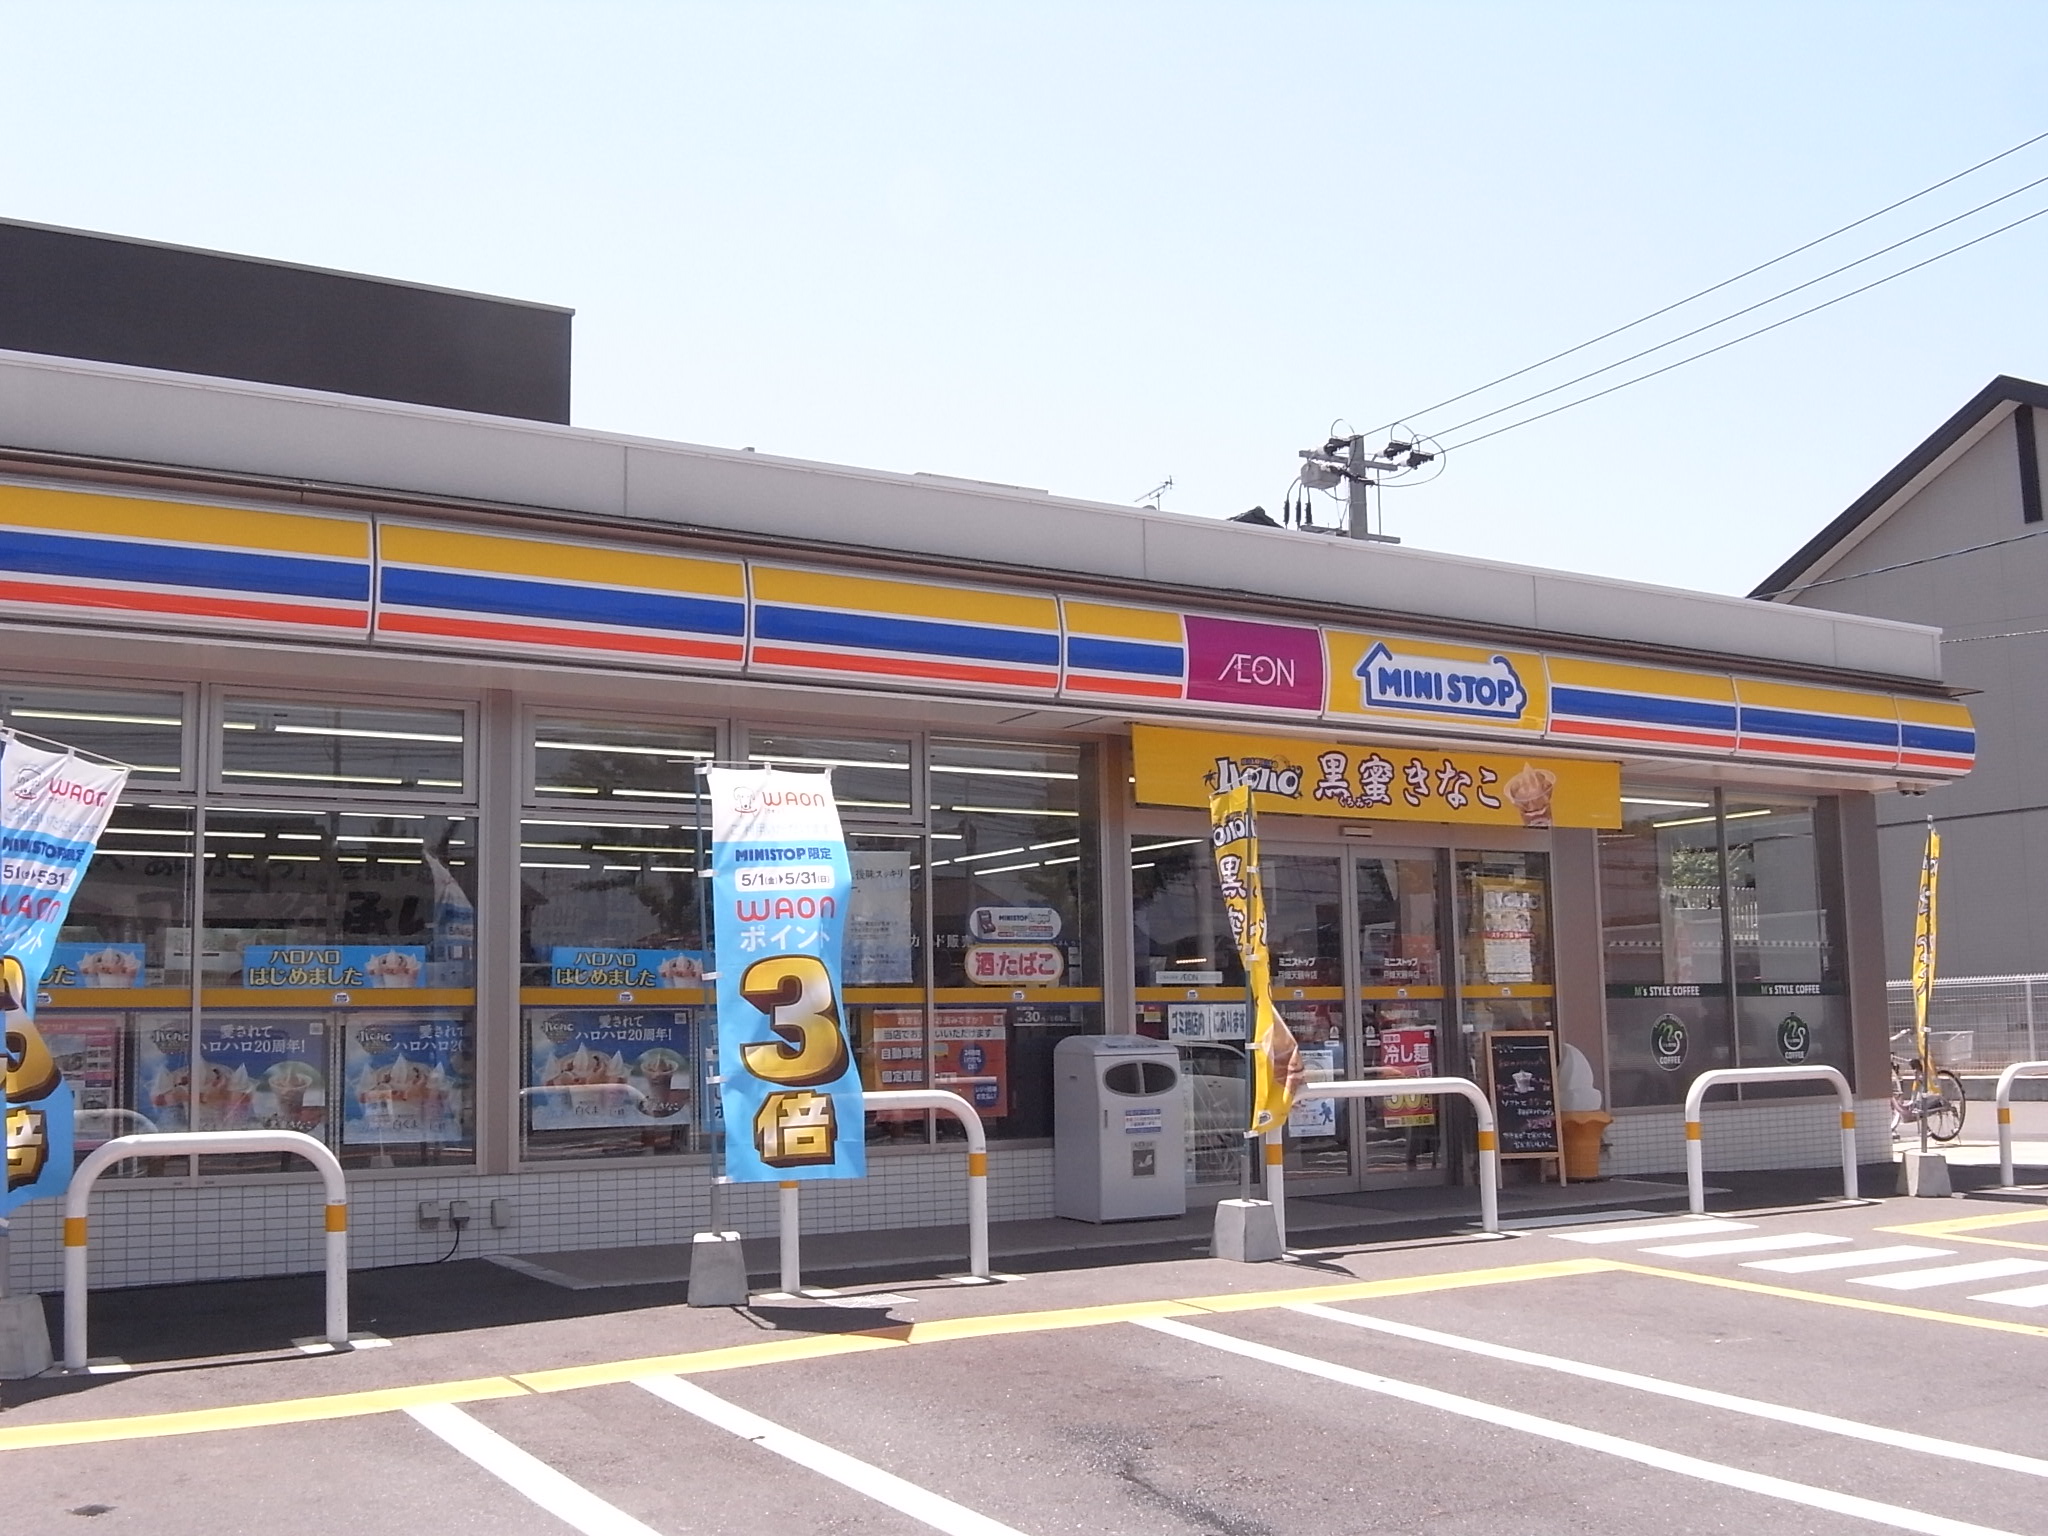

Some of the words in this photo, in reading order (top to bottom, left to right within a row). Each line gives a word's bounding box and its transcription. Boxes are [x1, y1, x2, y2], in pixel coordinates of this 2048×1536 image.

[1313, 751, 1501, 809] 黒蜜きなこ
[762, 791, 825, 807] WAON
[735, 848, 806, 862] MINISTOP
[807, 847, 833, 860] 限定
[736, 896, 836, 922] WAON
[740, 923, 830, 952] ポイント
[269, 950, 341, 965] ハロハロ
[575, 953, 637, 967] ハロハロ
[1278, 957, 1316, 967] ミニストップ
[1384, 957, 1418, 967] ミニストップ
[248, 968, 363, 986] はじめました
[555, 968, 656, 987] はじめました
[1649, 985, 1671, 996] STYLE
[1672, 985, 1700, 996] COFFEE
[1774, 984, 1794, 995] STYLE
[1795, 984, 1821, 994] COFFEE
[598, 1015, 645, 1028] 愛されて
[740, 953, 849, 1087] 3
[220, 1024, 273, 1039] 愛されて
[1383, 1043, 1430, 1064] 冷し麺
[1659, 1055, 1682, 1065] COFFEE
[752, 1090, 838, 1168] 倍
